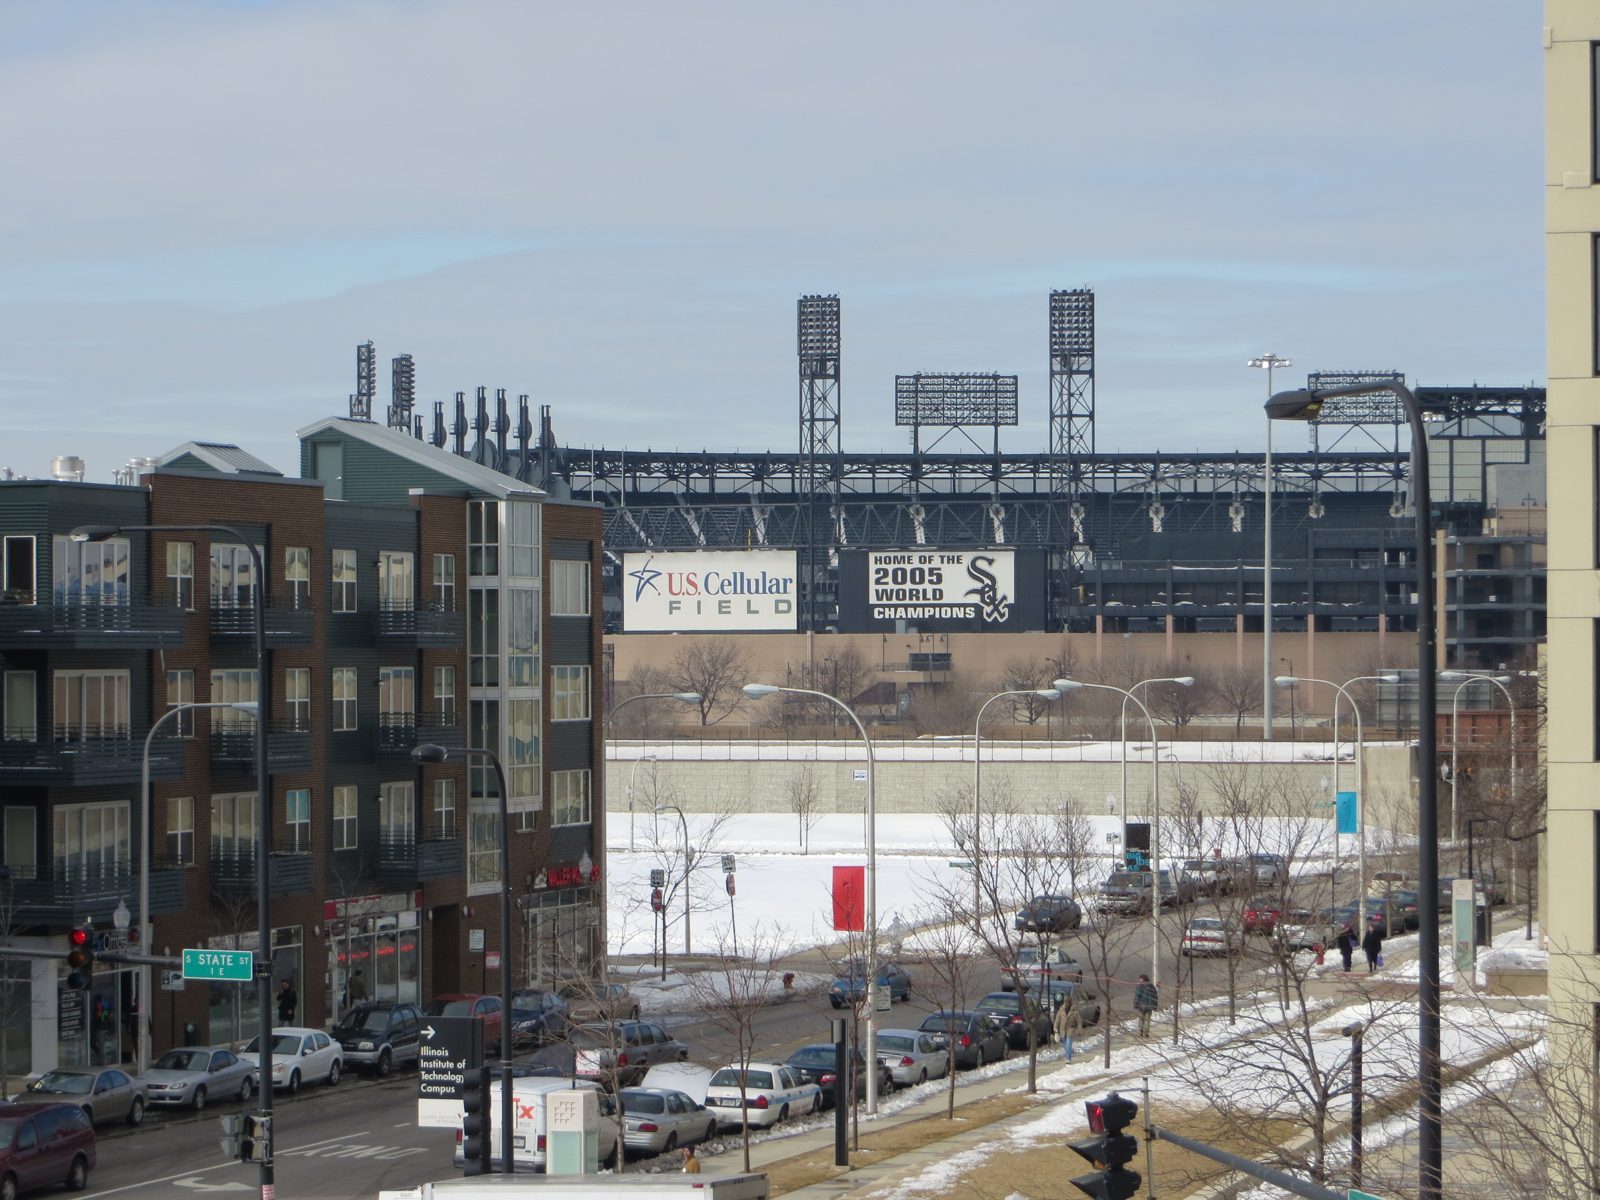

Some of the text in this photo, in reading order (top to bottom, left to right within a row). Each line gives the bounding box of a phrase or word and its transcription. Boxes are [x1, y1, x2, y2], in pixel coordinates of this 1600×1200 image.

[874, 555, 963, 565] HOME OF THE
[874, 567, 943, 586] 2005
[666, 571, 793, 597] U.S. Cellular
[874, 588, 944, 602] WORLD
[668, 599, 792, 615] FIELD
[873, 607, 976, 619] CHAMPIONS
[185, 953, 249, 966] S STATE ST
[219, 967, 225, 976] E
[420, 1046, 449, 1057] Illinois
[420, 1058, 467, 1069] Institute of
[420, 1083, 455, 1095] Campus
